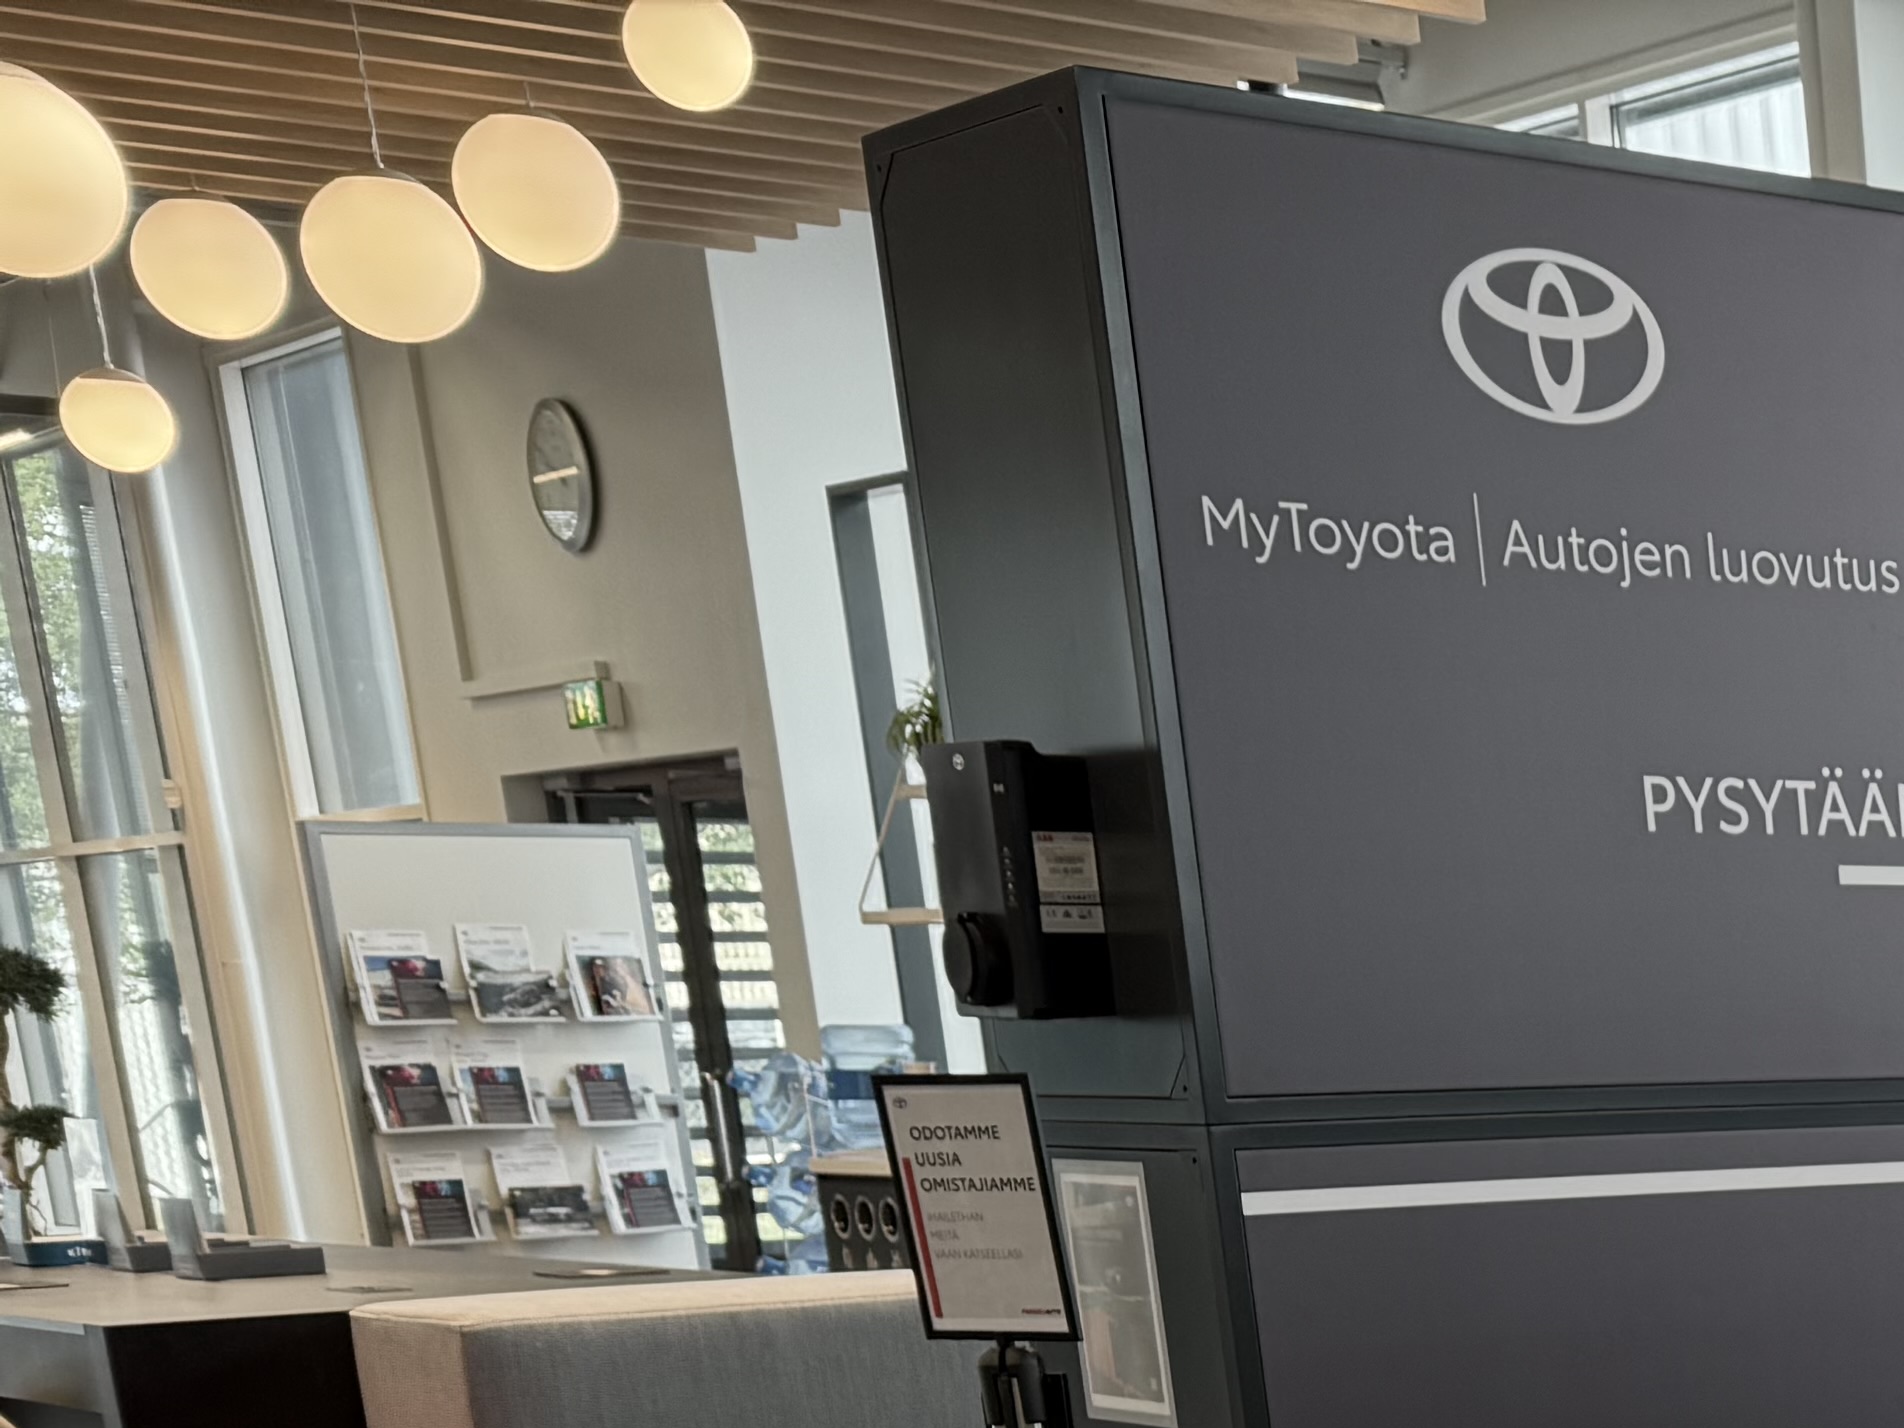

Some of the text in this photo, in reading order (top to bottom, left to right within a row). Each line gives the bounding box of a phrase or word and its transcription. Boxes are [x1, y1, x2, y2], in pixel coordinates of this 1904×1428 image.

[1200, 494, 1901, 595] MyToyota Autojen luovutus
[909, 1124, 1001, 1141] ODOTAMME
[914, 1151, 962, 1167] UUSIA
[920, 1176, 1037, 1193] OMISTAJIAMME
